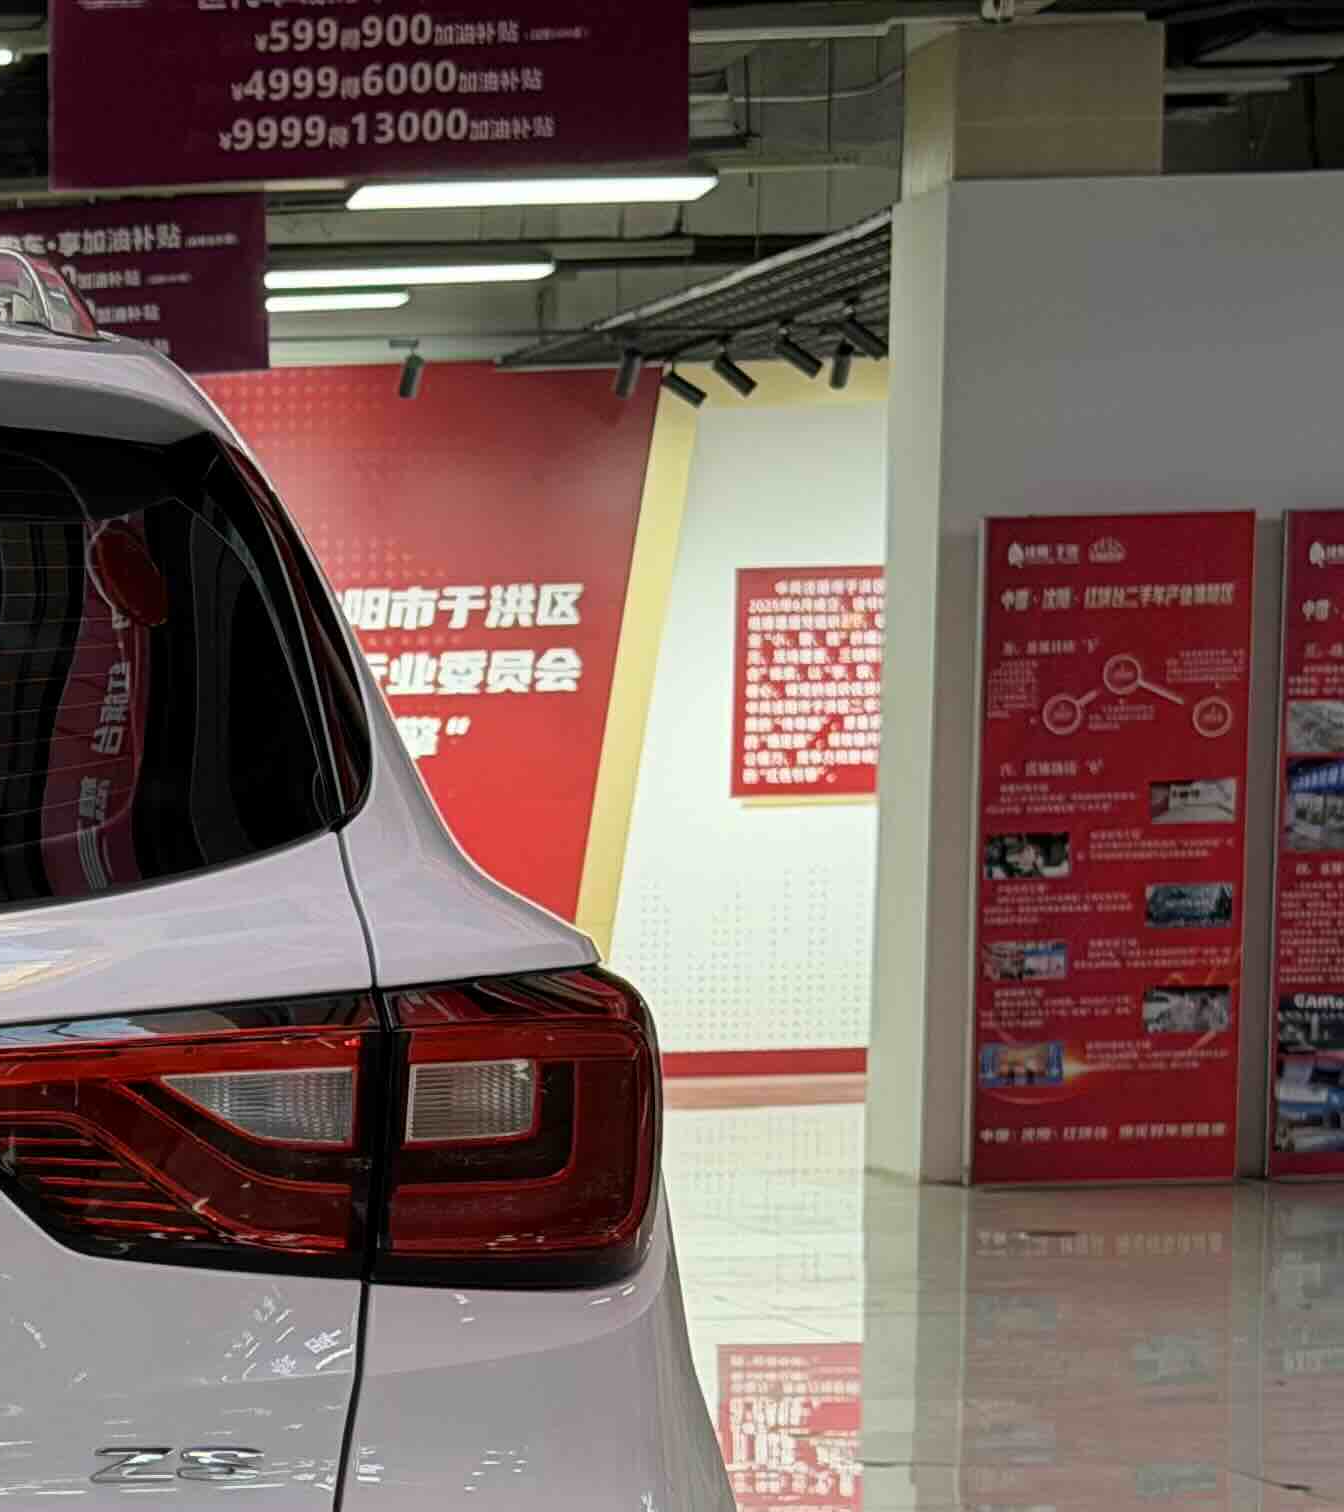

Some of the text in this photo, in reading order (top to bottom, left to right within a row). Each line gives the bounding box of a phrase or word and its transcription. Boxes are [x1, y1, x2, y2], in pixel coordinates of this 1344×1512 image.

[340, 582, 584, 632] 阳市于洪区
[90, 1447, 265, 1484] ZS
